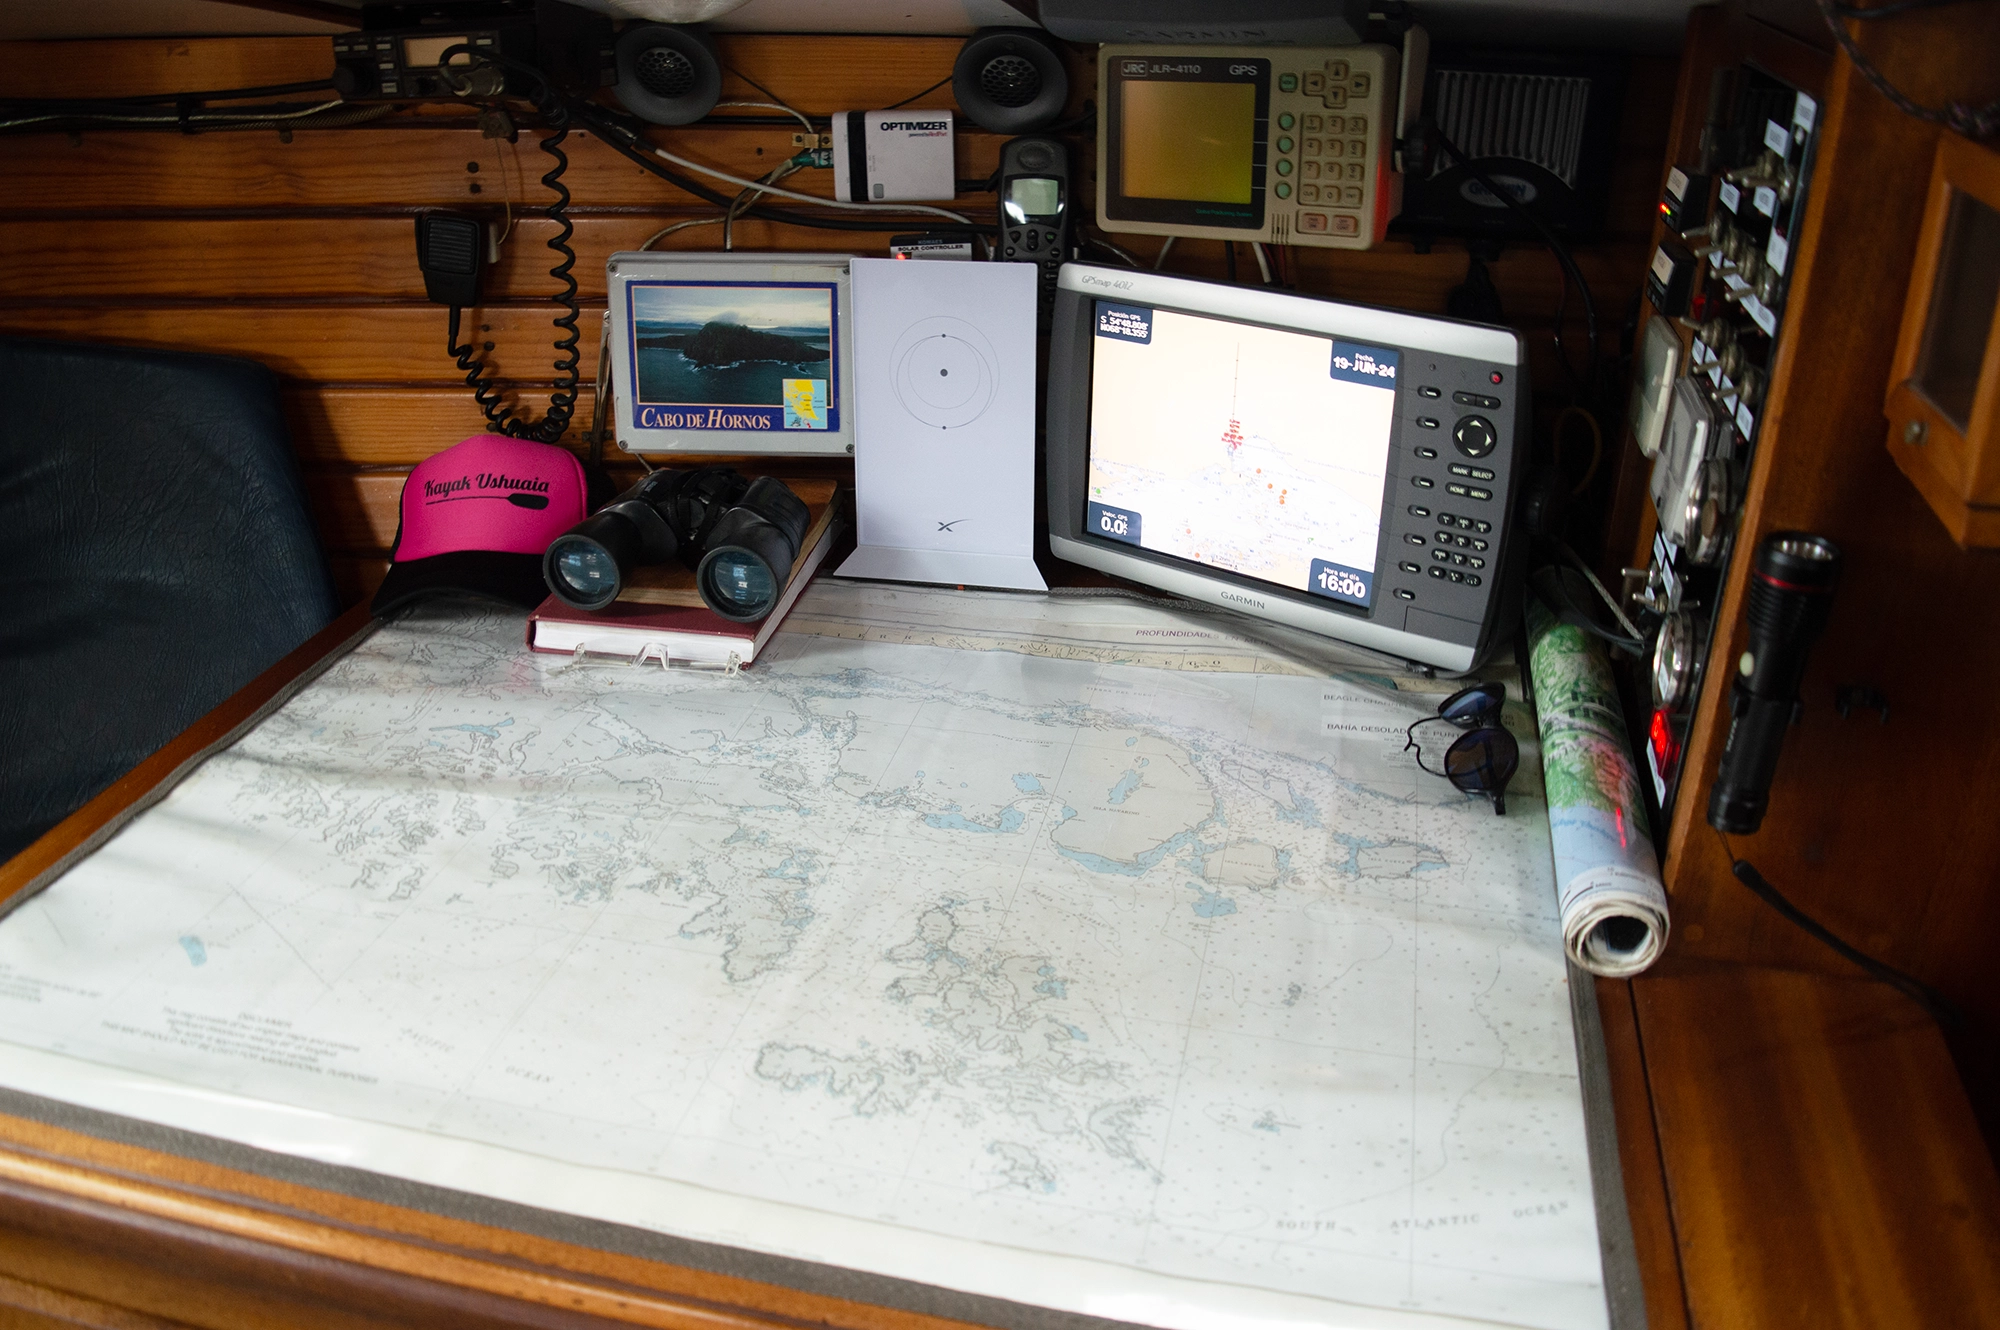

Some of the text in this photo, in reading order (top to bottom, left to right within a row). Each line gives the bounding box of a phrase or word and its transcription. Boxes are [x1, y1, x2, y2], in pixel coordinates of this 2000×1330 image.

[1123, 64, 1259, 76] JRC JLR-4110 GPS
[880, 122, 948, 131] OPTIMIZER
[1081, 275, 1134, 291] GPSmap 4012
[1100, 315, 1107, 323] S
[1355, 353, 1374, 363] Fecha
[1333, 356, 1396, 379] 19-JUN-24
[641, 408, 771, 430] CABO DE HORNOS
[1452, 466, 1469, 475] MARK
[1471, 470, 1493, 480] SELECT
[424, 473, 550, 498] Kayak Ushuaia
[1449, 486, 1465, 495] HOME
[1470, 490, 1488, 499] MENU
[1100, 516, 1124, 535] 0.0
[1323, 566, 1338, 576] Hora
[1317, 572, 1366, 599] 16:00
[1220, 591, 1265, 610] GARMIN
[1323, 694, 1359, 702] BEAGLE
[1327, 721, 1358, 732] BAHÍA
[504, 1065, 555, 1084] OCEAN
[1275, 1199, 1568, 1231] SOUTH ATLANTIC OCEAN
